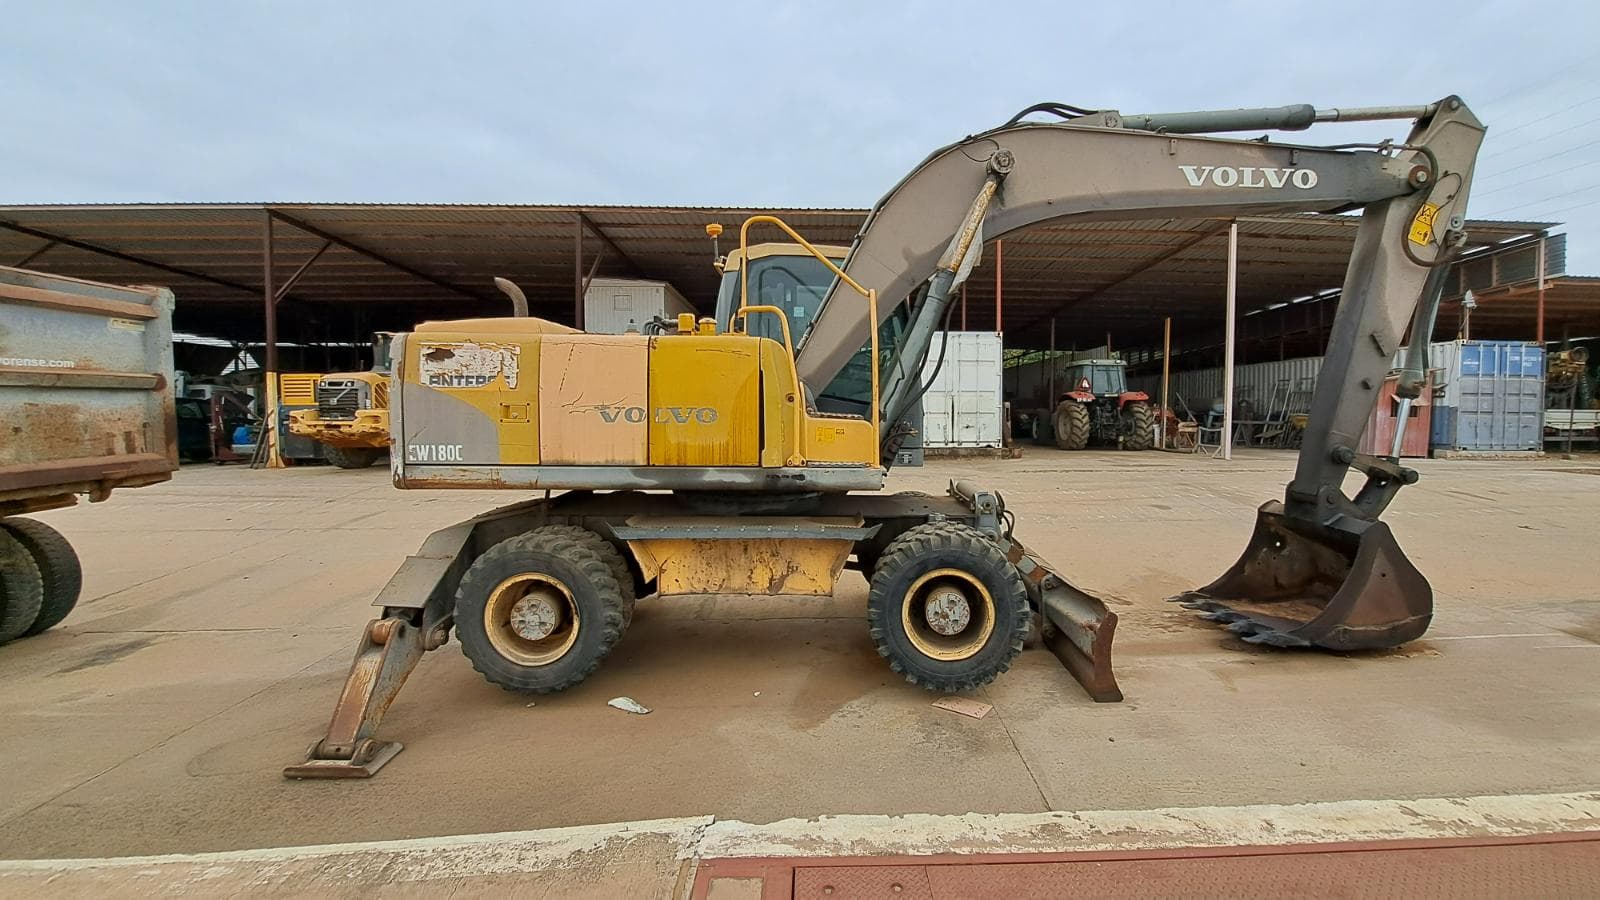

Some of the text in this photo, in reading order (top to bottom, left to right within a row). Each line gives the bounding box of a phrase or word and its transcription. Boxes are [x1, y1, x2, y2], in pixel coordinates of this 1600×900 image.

[1178, 165, 1318, 189] VOLVO
[0, 357, 75, 368] orense.com
[594, 406, 718, 424] VOLVO
[408, 444, 463, 461] EW180C
